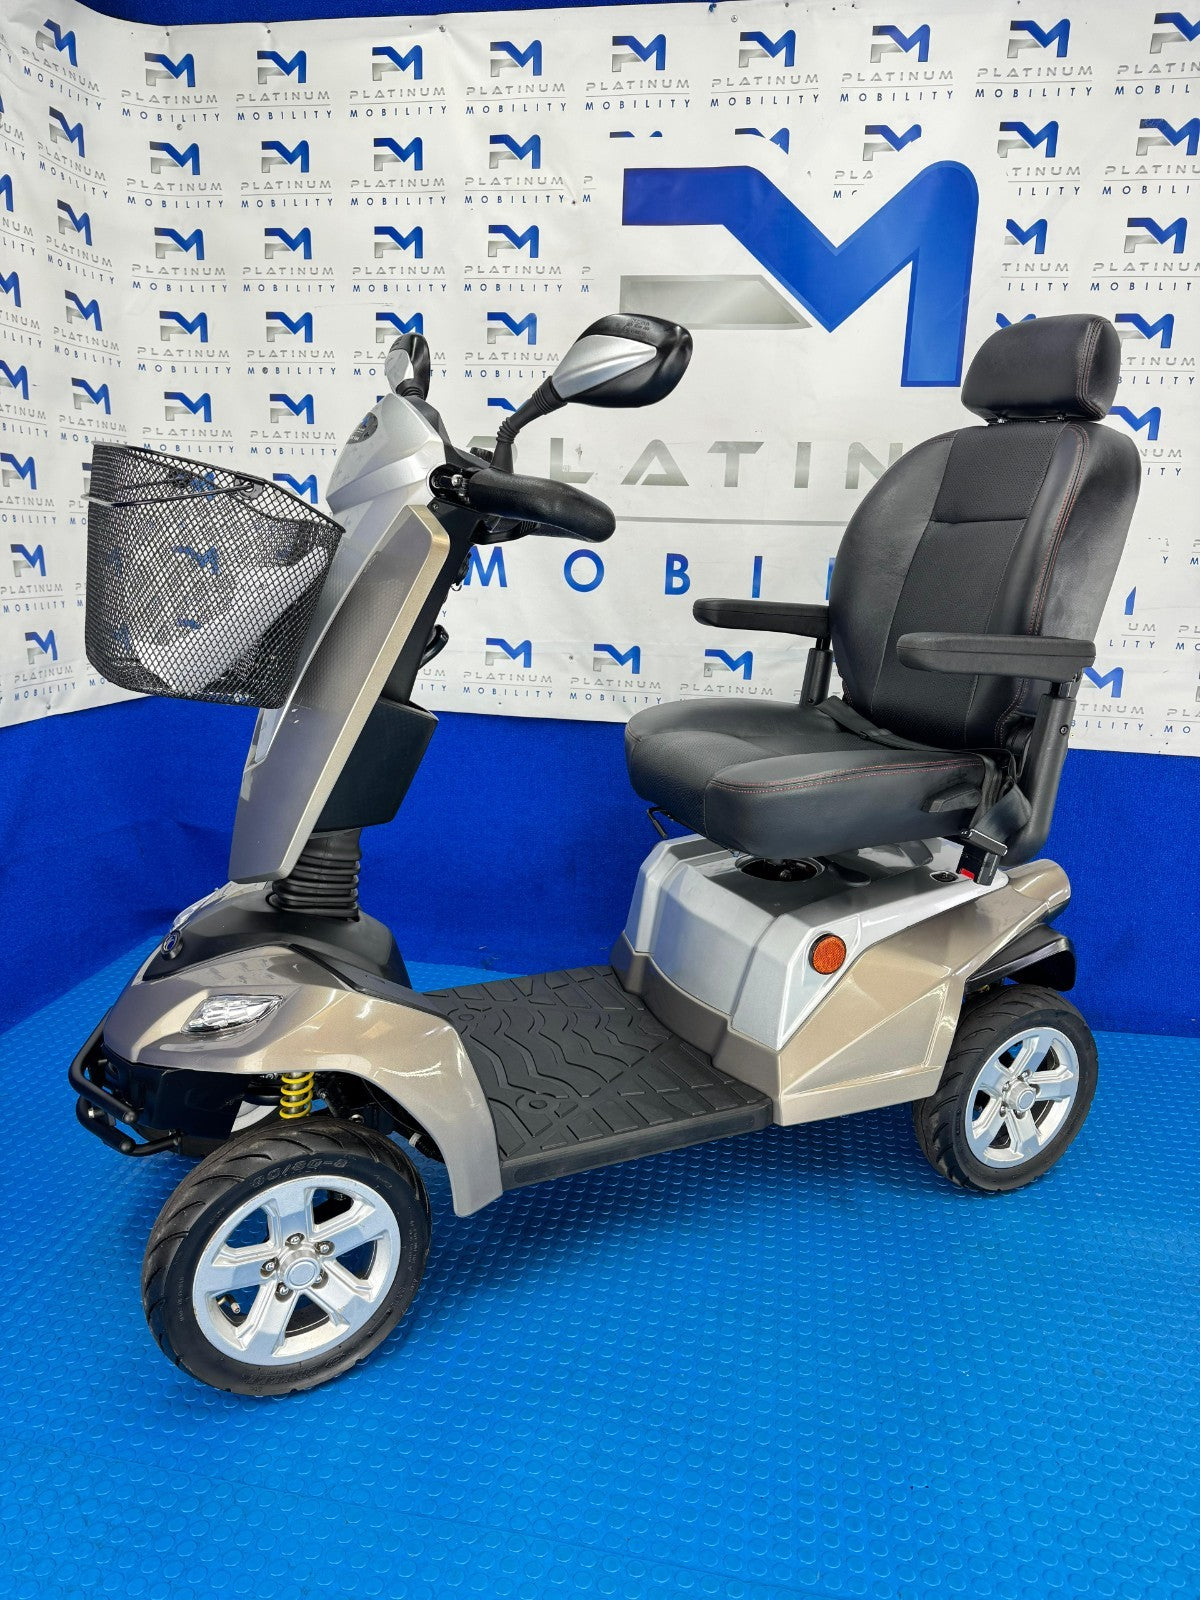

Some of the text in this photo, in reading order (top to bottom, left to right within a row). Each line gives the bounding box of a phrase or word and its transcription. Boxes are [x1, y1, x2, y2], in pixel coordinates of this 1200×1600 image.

[21, 46, 99, 92] PLATINUM
[977, 66, 1092, 78] PLATINUM
[712, 74, 818, 87] PLATINUM
[841, 70, 953, 83] PLATINUM
[23, 66, 101, 110] MOBILITY
[466, 83, 565, 95] PLATINUM
[586, 79, 689, 91] PLATINUM
[121, 90, 218, 104] PLATINUM
[236, 91, 330, 102] PLATINUM
[349, 87, 445, 99] PLATINUM
[840, 90, 953, 102] MOBILITY
[975, 87, 1092, 98] MOBILITY
[585, 99, 690, 111] MOBILITY
[711, 94, 819, 107] MOBILITY
[350, 106, 447, 117] MOBILITY
[466, 103, 566, 114] MOBILITY
[122, 108, 220, 122] MOBILITY
[237, 110, 332, 120] MOBILITY
[37, 142, 106, 181] PLATINUM
[39, 161, 108, 198] MOBILITY
[127, 178, 223, 191] PLATINUM
[241, 180, 331, 190] PLATINUM
[350, 178, 445, 188] PLATINUM
[465, 176, 563, 186] PLATINUM
[128, 196, 224, 208] MOBILITY
[241, 199, 333, 208] MOBILITY
[351, 197, 446, 205] MOBILITY
[464, 195, 564, 204] MOBILITY
[46, 236, 113, 267] PLATINUM
[47, 254, 114, 285] MOBILITY
[132, 264, 225, 275] PLATINUM
[243, 267, 333, 275] PLATINUM
[352, 267, 445, 275] PLATINUM
[464, 266, 561, 274] PLATINUM
[132, 281, 227, 293] MOBILITY
[243, 284, 335, 293] MOBILITY
[353, 284, 446, 292] MOBILITY
[464, 284, 563, 292] MOBILITY
[53, 327, 119, 351] PLATINUM
[54, 345, 122, 368] MOBILITY
[137, 347, 230, 357] PLATINUM
[247, 350, 334, 358] PLATINUM
[465, 352, 559, 361] PLATINUM
[138, 363, 231, 374] MOBILITY
[465, 370, 546, 378] MOBILIT
[59, 415, 127, 432] PLATINUM
[143, 427, 233, 438] PLATINUM
[250, 431, 336, 439] PLATINUM
[143, 443, 234, 453] MOBILITY
[251, 447, 337, 456] MOBILITY
[0, 584, 63, 593] PLATINUM
[3, 600, 65, 614] MOBILITY
[15, 666, 73, 683] PLATINUM
[463, 672, 552, 683] PLATINUM
[570, 677, 661, 690] PLATINUM
[14, 683, 76, 701] MOBILITY
[463, 687, 552, 698] MOBILITY
[680, 684, 773, 696] PLATINUM
[569, 692, 662, 705] MOBILITY
